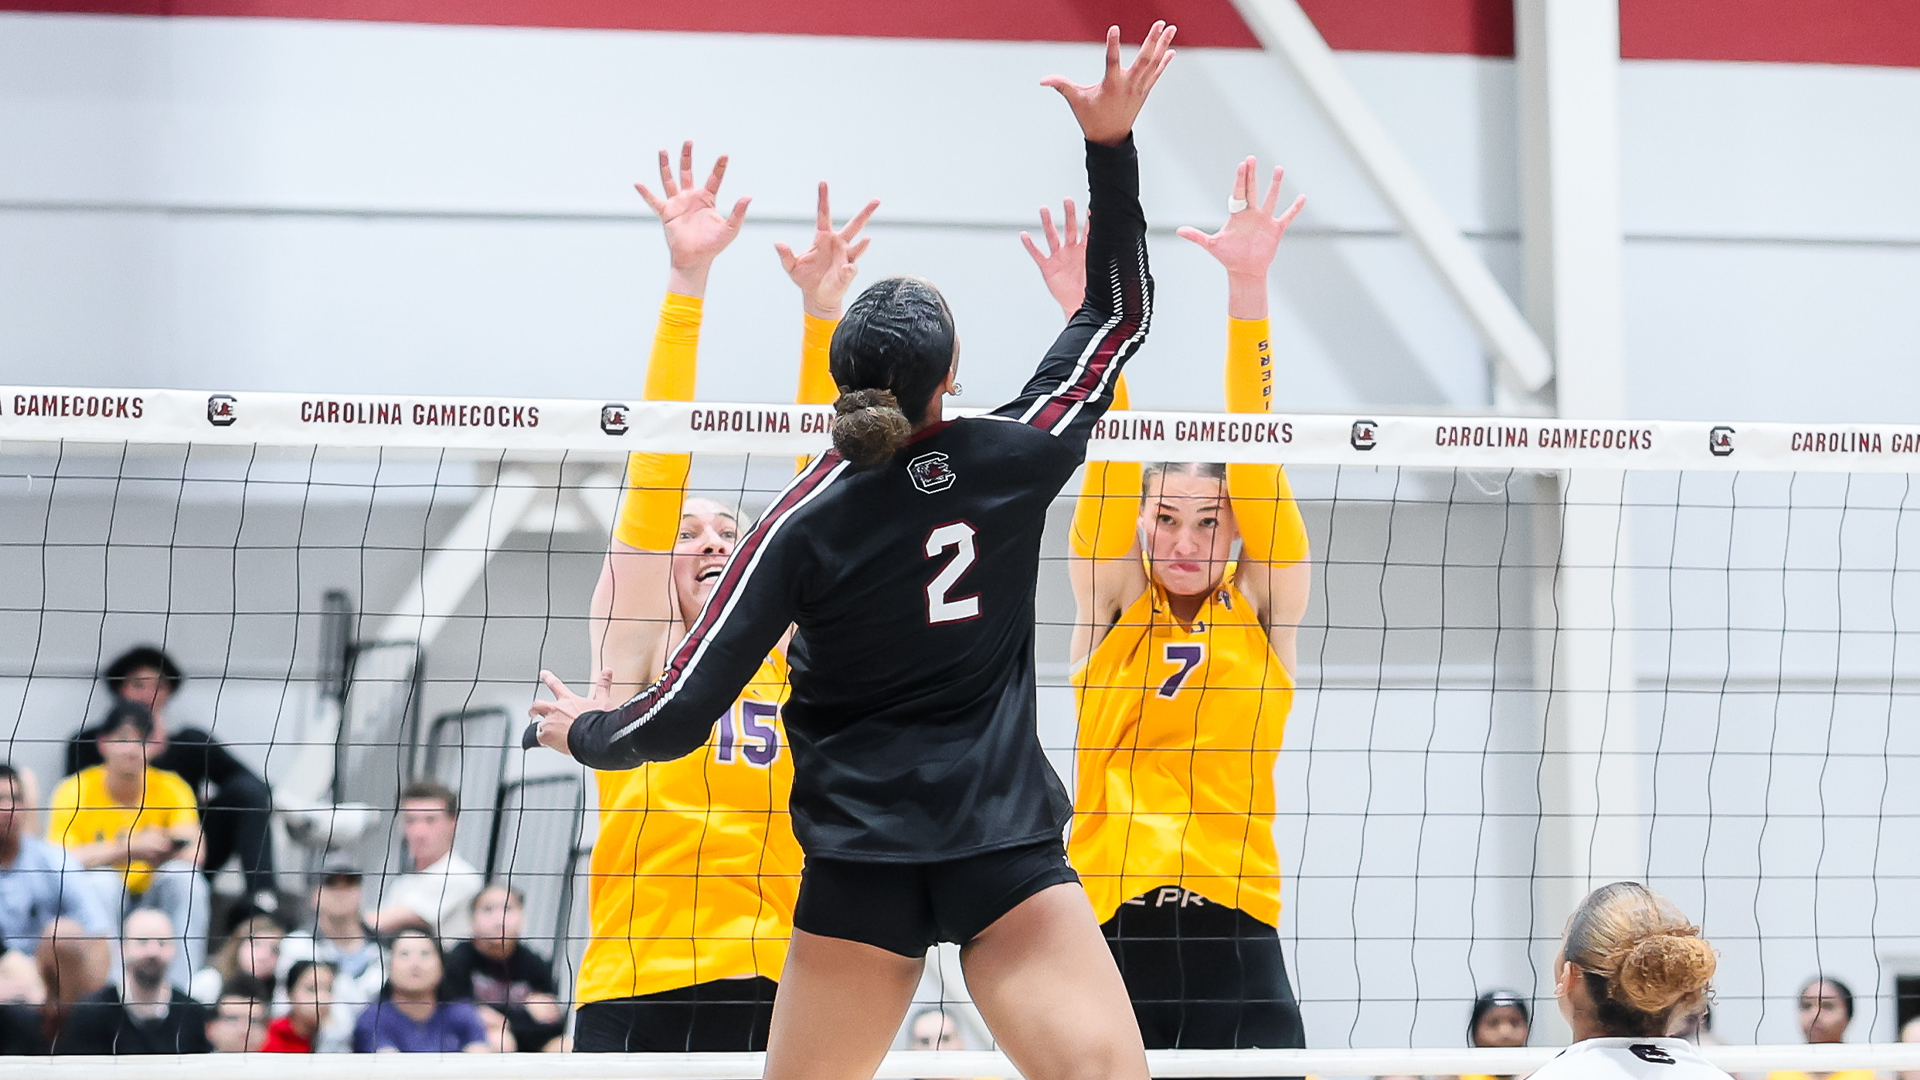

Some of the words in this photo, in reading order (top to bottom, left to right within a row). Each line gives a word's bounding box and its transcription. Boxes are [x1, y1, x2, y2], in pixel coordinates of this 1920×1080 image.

[1258, 339, 1272, 411] IGERS
[13, 394, 144, 419] GAMECOCKS
[301, 401, 403, 425] CAROLINA
[412, 403, 539, 428] GAMECOCKS
[690, 409, 790, 433] CAROLINA
[1175, 420, 1293, 443] GAMECOCKS
[1435, 426, 1528, 448] CAROLINA
[1538, 428, 1652, 450] GAMECOCKS
[1791, 432, 1882, 453] CAROLINA
[923, 518, 983, 626] 2
[1157, 643, 1204, 699] 7
[716, 699, 781, 767] 15
[1155, 888, 1206, 908] PR
